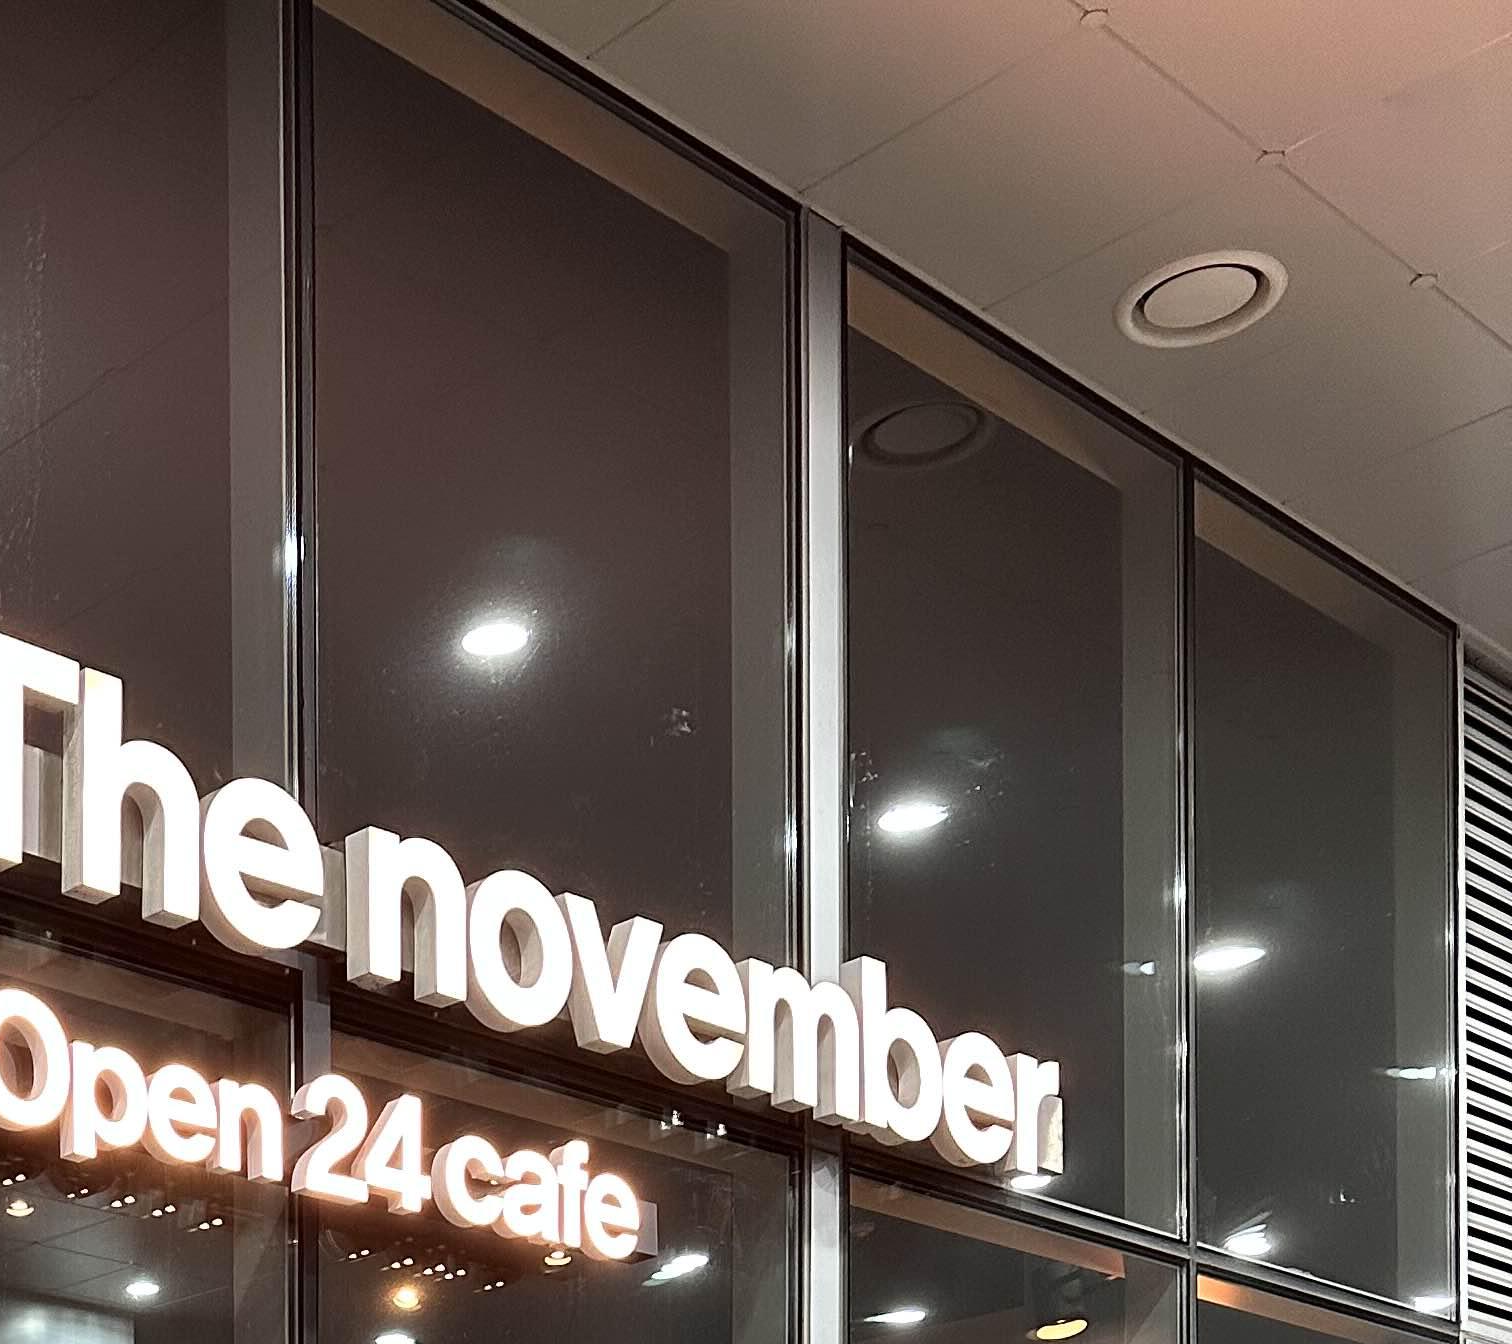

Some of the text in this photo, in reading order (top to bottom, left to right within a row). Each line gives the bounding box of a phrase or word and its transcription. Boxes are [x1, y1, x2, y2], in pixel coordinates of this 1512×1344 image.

[346, 826, 1064, 1176] november
[291, 1073, 431, 1214] 24
[431, 1136, 641, 1262] cafe
